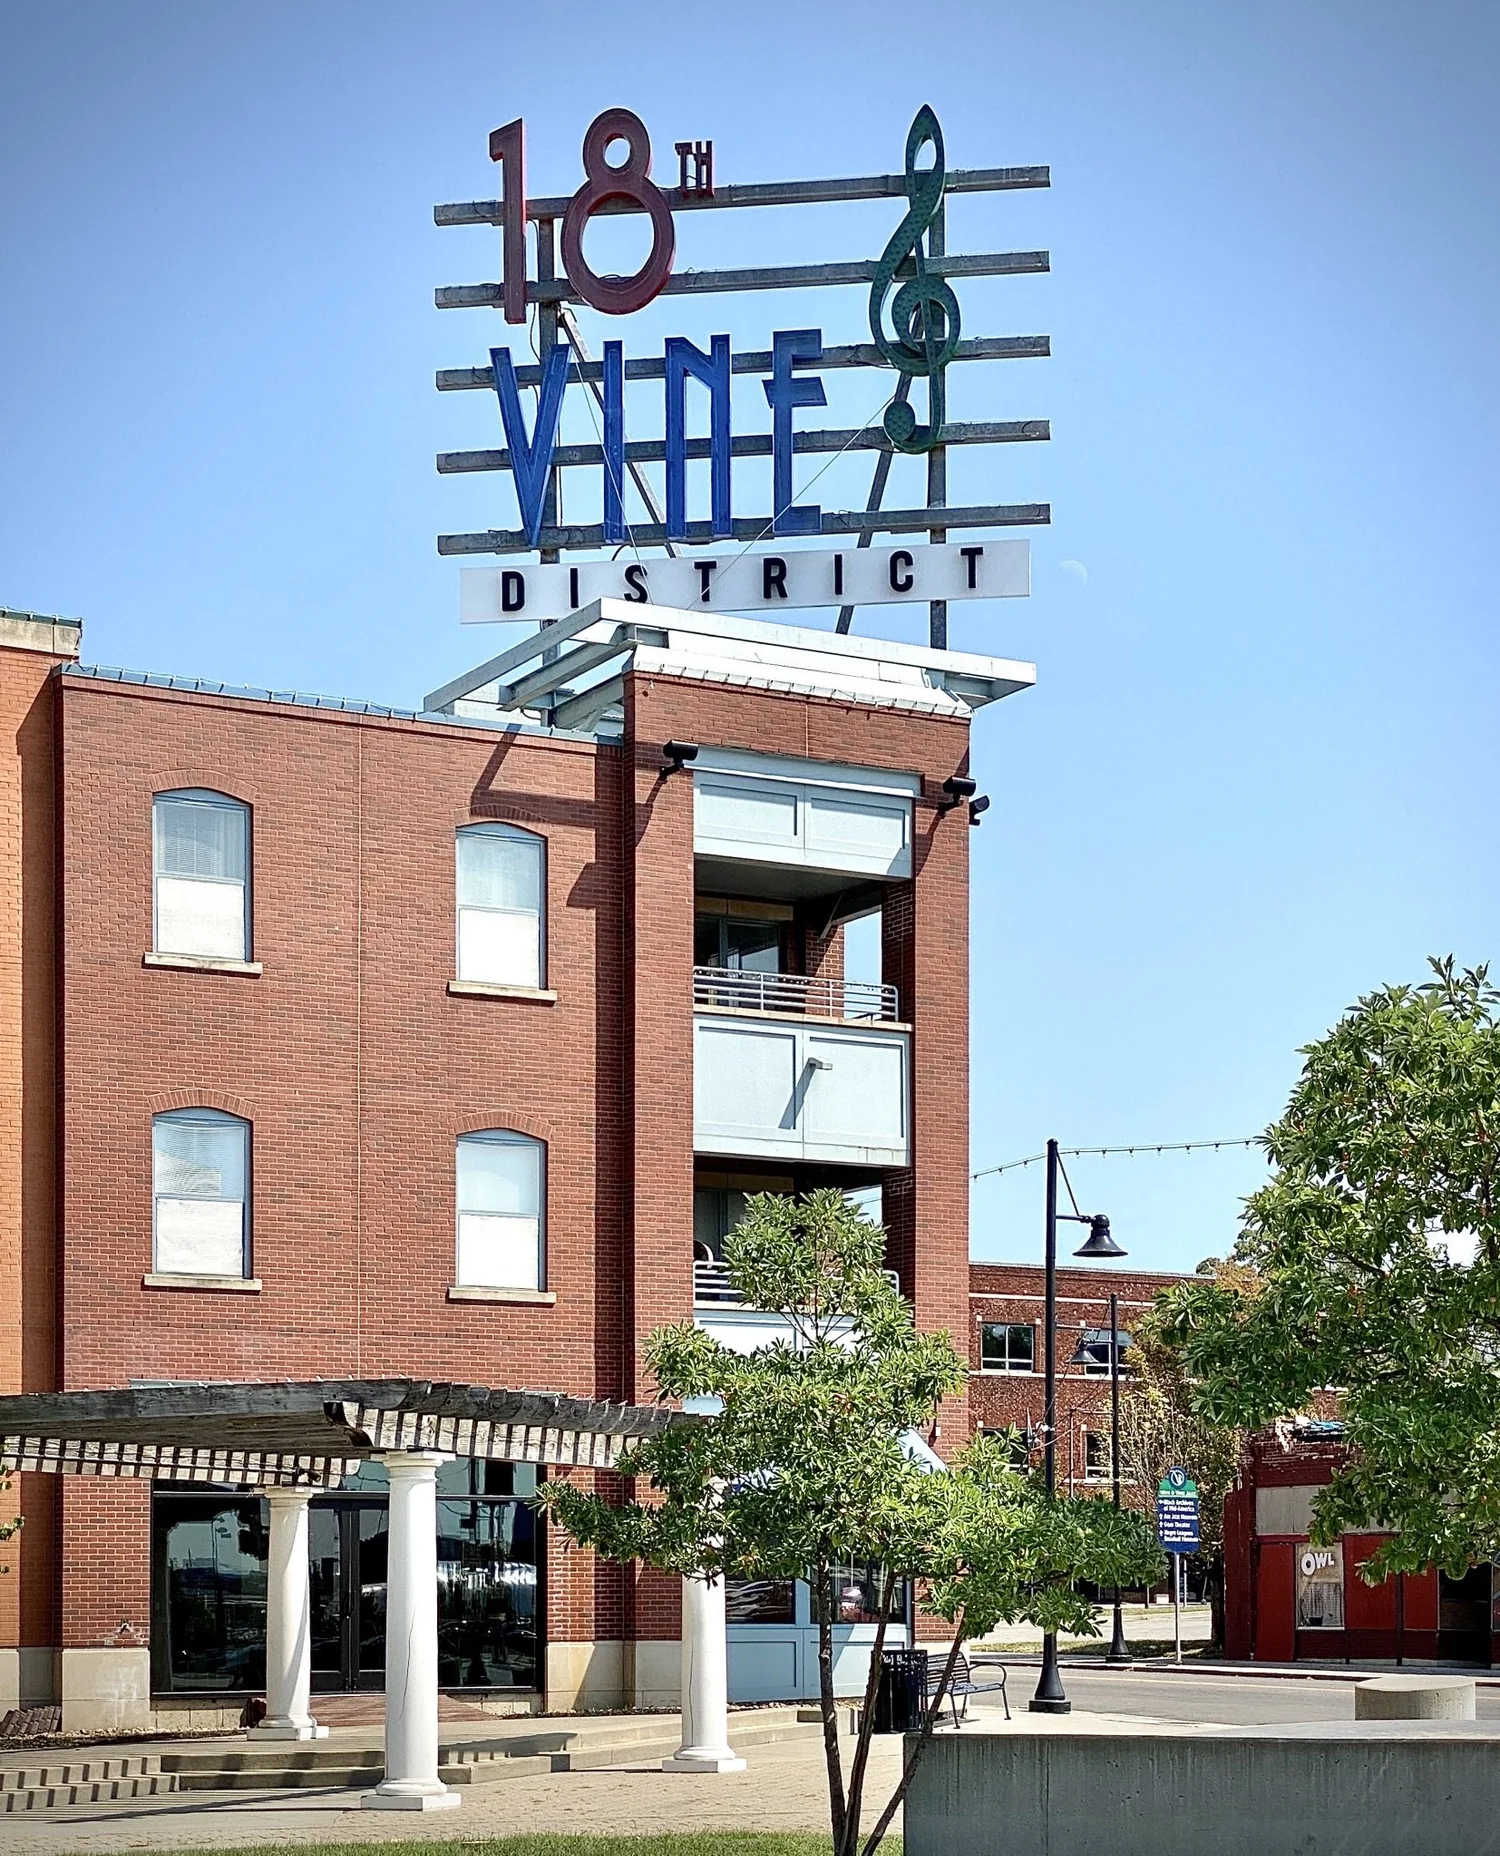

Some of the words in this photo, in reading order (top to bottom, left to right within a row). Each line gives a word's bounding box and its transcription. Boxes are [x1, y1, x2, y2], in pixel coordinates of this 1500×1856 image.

[489, 328, 828, 546] VINE
[501, 545, 984, 612] DISTRICT
[1301, 1552, 1335, 1576] OWL
